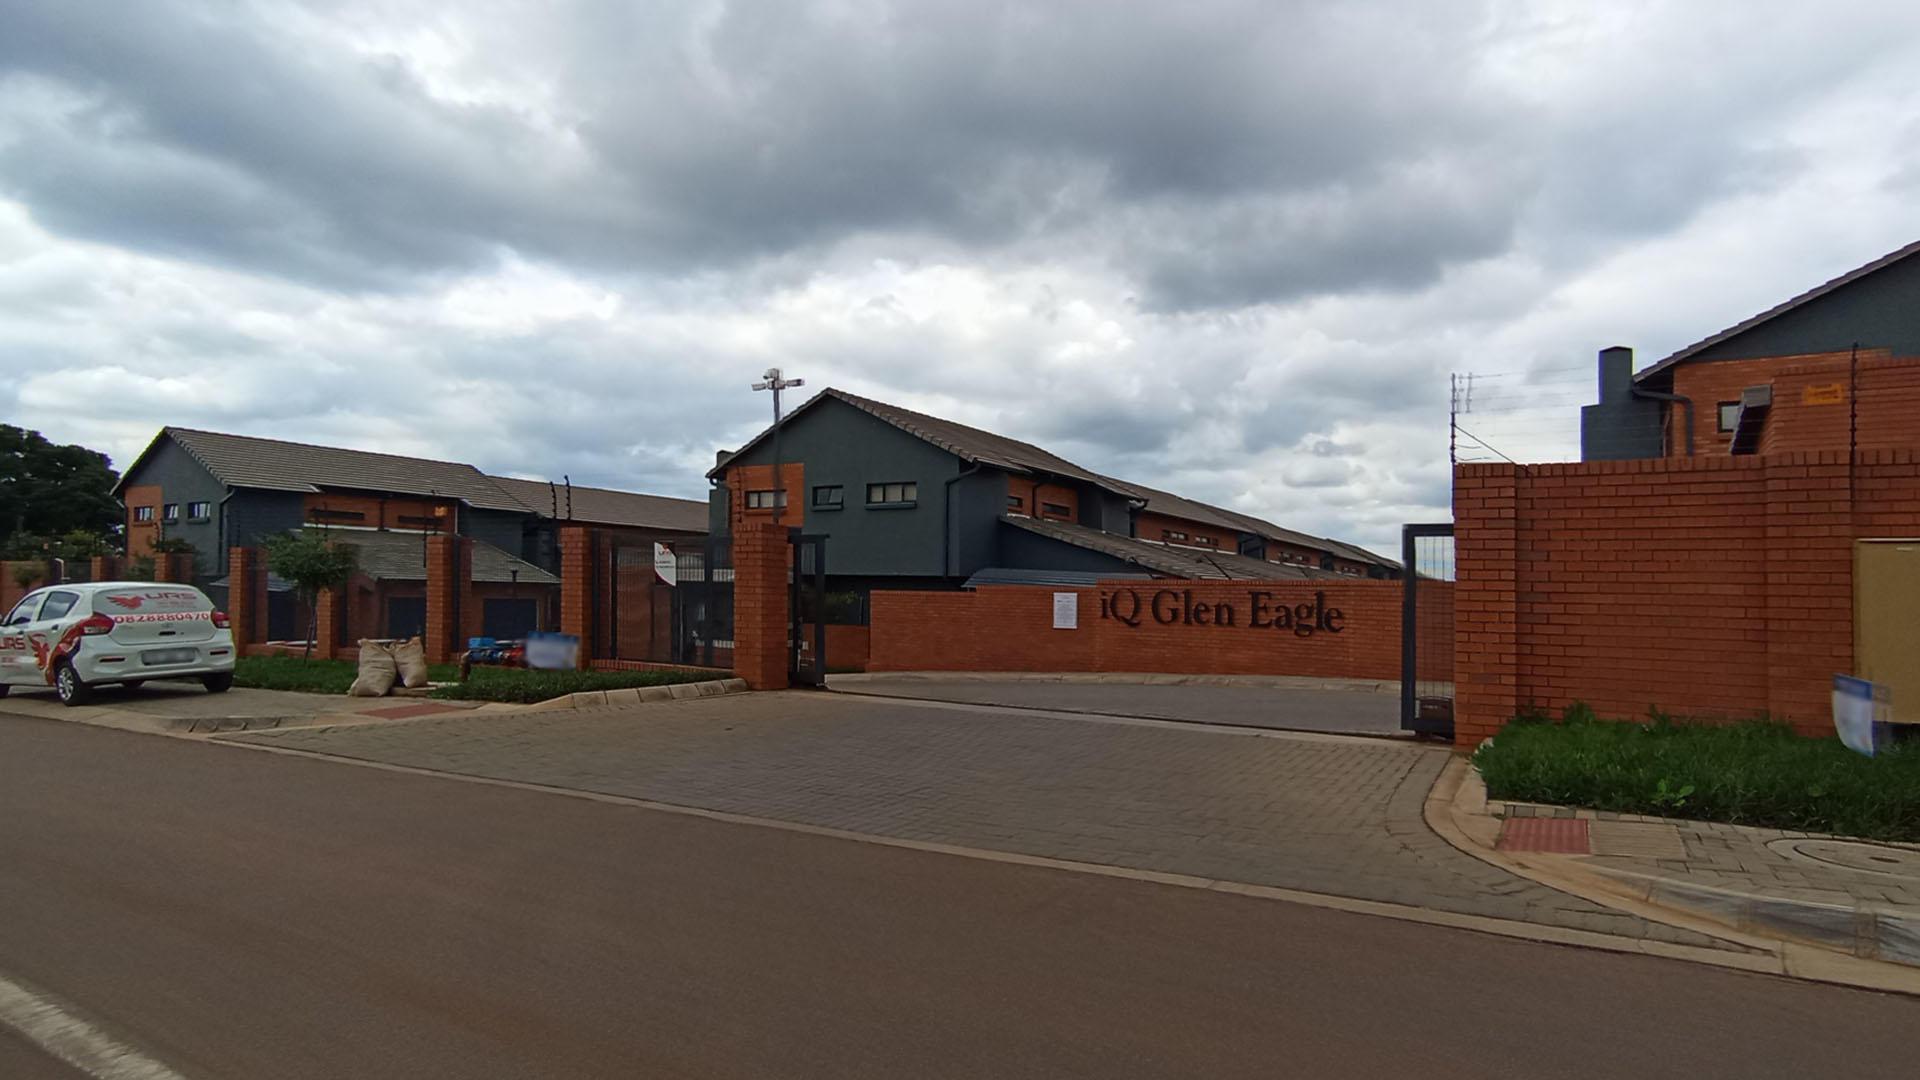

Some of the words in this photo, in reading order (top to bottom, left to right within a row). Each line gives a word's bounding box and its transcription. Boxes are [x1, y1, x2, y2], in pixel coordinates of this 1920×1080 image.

[114, 612, 209, 624] 0828880470
[1100, 588, 1141, 627] iQ
[1151, 588, 1236, 627] Glen
[1248, 590, 1345, 637] Eagle
